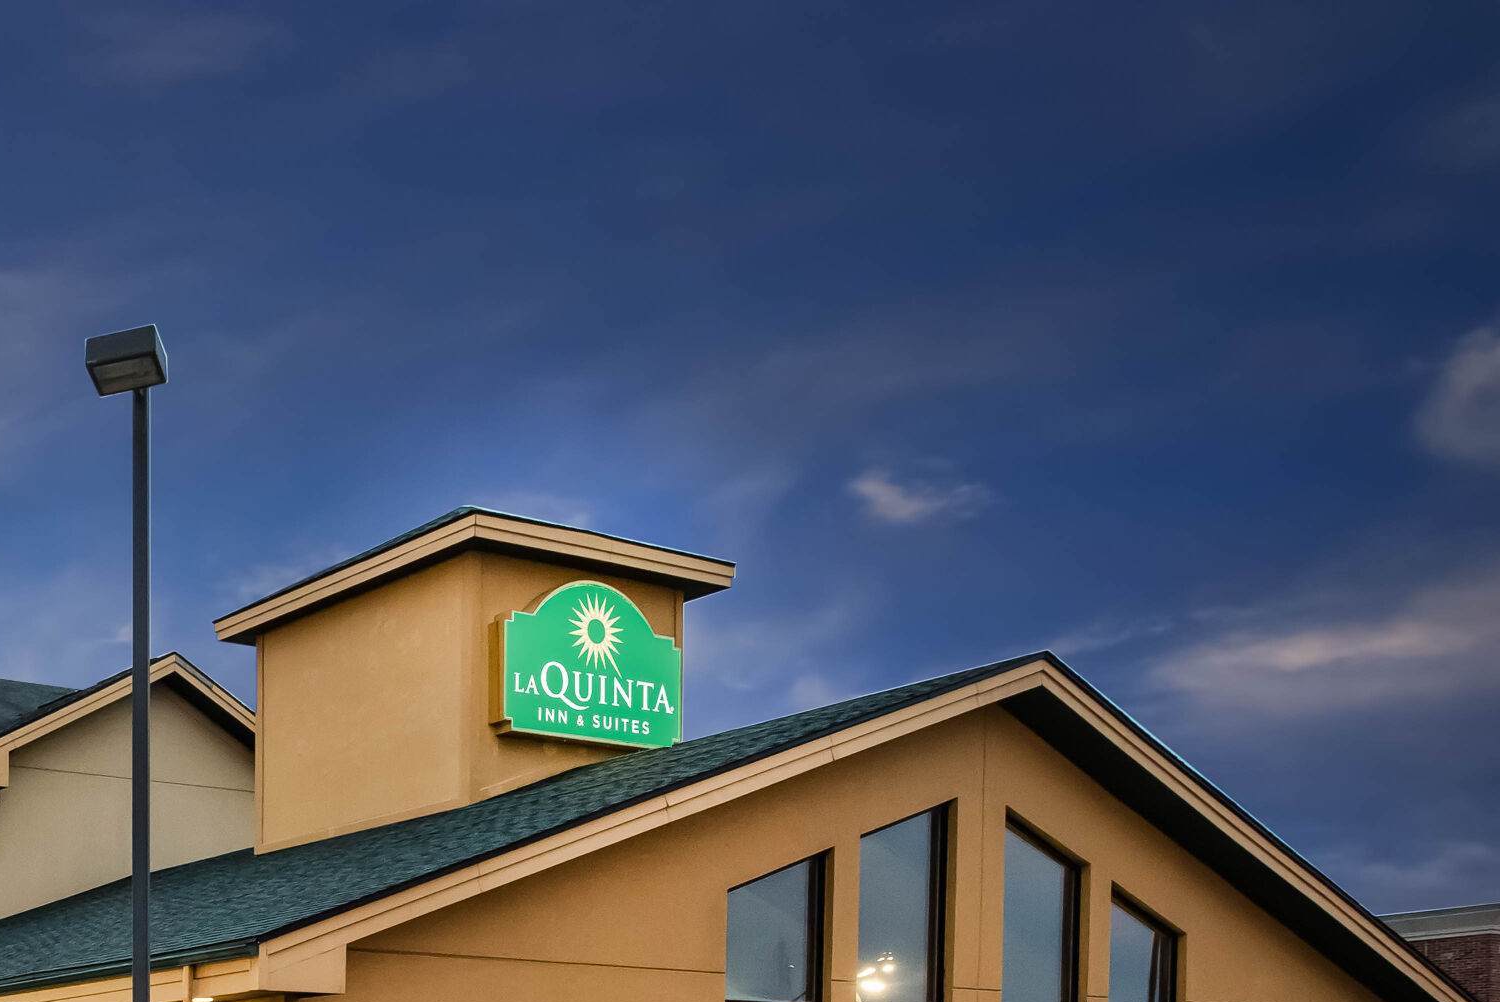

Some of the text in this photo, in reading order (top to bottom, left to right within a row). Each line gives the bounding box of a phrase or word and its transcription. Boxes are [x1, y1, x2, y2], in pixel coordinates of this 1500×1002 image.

[513, 660, 672, 715] LA QUINTA
[537, 706, 651, 735] INN & SUITES
